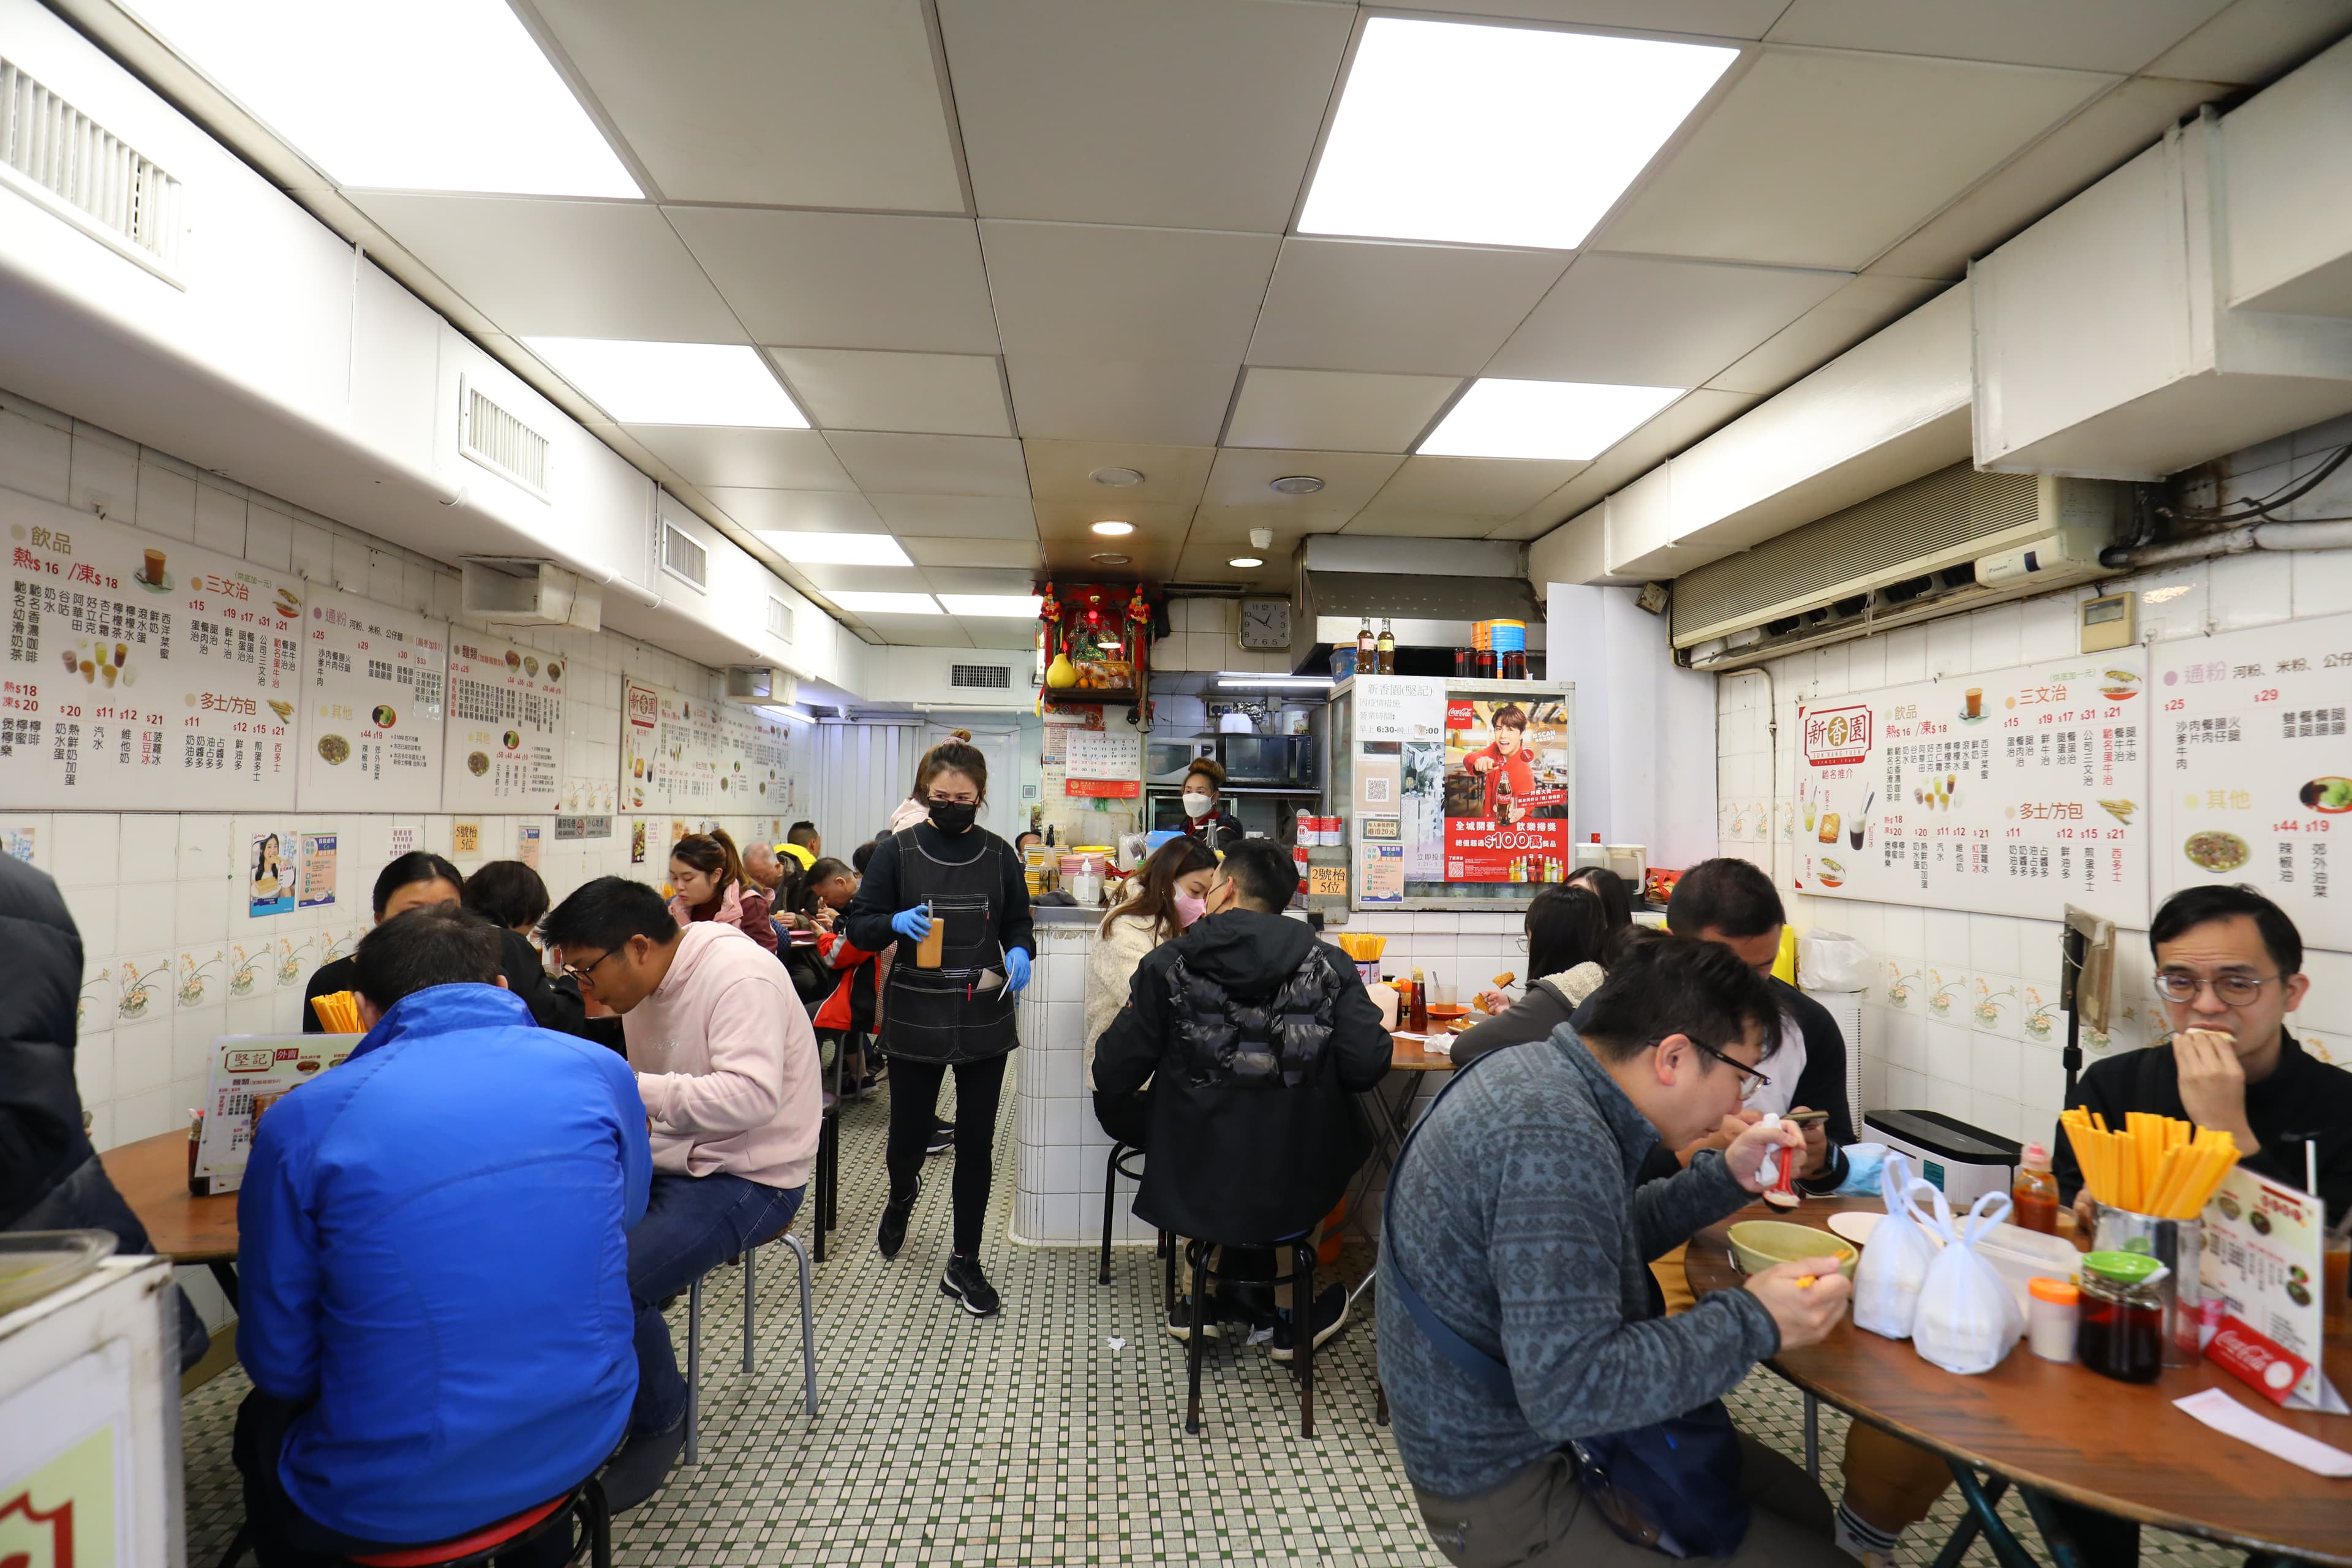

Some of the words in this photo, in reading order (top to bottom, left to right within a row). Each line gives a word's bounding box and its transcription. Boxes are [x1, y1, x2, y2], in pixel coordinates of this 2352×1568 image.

[31, 526, 72, 556] 飲品
[206, 575, 249, 601] 三文治
[43, 587, 56, 612] 奶水
[58, 590, 70, 616] 谷咕
[189, 600, 204, 611] $15
[10, 580, 26, 662] 馳名幼滑奶茶
[72, 593, 84, 631] 阿華田
[85, 596, 97, 634] 好立克
[99, 600, 110, 637] 杏仁霜
[111, 602, 123, 639] 檸檬茶
[224, 608, 236, 618] $19
[241, 612, 254, 622] $17
[325, 608, 347, 627] 通粉
[26, 584, 42, 663] 馳名香濃咖啡
[124, 605, 135, 641] 檸檬水
[137, 608, 148, 643] 滾水蛋
[149, 611, 159, 634] 鮮奶
[190, 620, 200, 642] 蛋治
[258, 617, 270, 627] $31
[276, 621, 287, 631] $21
[160, 613, 171, 660] 西洋菜蜜
[200, 622, 209, 655] 餐肉治
[209, 624, 218, 646] 腿治
[224, 627, 233, 659] 鮮牛治
[313, 631, 324, 639] $25
[258, 635, 267, 686] 公司三文治
[325, 650, 332, 668] 肉片
[462, 645, 477, 660] 麵類
[2185, 661, 2226, 685] 通粉
[1368, 684, 1433, 696] 新香園(堅記)
[2020, 684, 2067, 704] 三文治
[2254, 689, 2278, 702] $29
[97, 707, 113, 718] $11
[201, 692, 256, 715] 多士/方包
[332, 704, 353, 720] 其他
[1449, 707, 1472, 717] Coca-Cola
[1894, 704, 1917, 720] 飲品
[2105, 707, 2120, 717] $21
[2165, 699, 2185, 710] $25
[120, 709, 137, 720] $12
[147, 715, 163, 725] $21
[185, 717, 199, 726] $11
[2004, 717, 2019, 727] $15
[2039, 714, 2052, 724] $19
[2059, 712, 2073, 722] $17
[2081, 710, 2095, 720] $31
[15, 718, 28, 745] 檸蜜
[28, 720, 42, 745] 檸啡
[233, 722, 247, 731] $12
[253, 725, 266, 734] $15
[273, 726, 284, 736] $21
[1808, 714, 1866, 748] 新香園
[1, 718, 15, 756] 煲檸樂
[54, 723, 66, 760] 奶水蛋
[93, 726, 104, 750] 汽水
[119, 728, 132, 764] 維他奶
[2176, 721, 2187, 769] 沙爹牛肉
[65, 724, 80, 786] 熱鮮奶加蛋
[141, 731, 153, 764] 紅豆冰
[152, 732, 163, 766] 菠蘿冰
[185, 735, 194, 767] 奶油多
[206, 737, 215, 769] 油占多
[235, 739, 243, 770] 鮮油多
[253, 741, 263, 781] 煎蛋多士
[2083, 730, 2093, 786] 公司三文治
[2207, 790, 2251, 809] 其他
[2020, 802, 2083, 820] 多士/方包
[456, 827, 477, 837] 5號枱
[1456, 821, 1495, 831] 全城開蓋
[1517, 823, 1556, 831] 飲樂掃獎
[1953, 827, 1965, 836] $12
[2007, 828, 2020, 837] $11
[2057, 829, 2073, 839] $12
[2081, 829, 2097, 839] $15
[2107, 829, 2124, 839] $21
[2274, 821, 2299, 832] $44
[2305, 820, 2330, 832] $19
[461, 839, 473, 850] 5位
[1937, 843, 1944, 861] 汽水
[2084, 848, 2095, 892] 煎蛋多士
[2112, 848, 2122, 882] 西多士
[1312, 869, 1345, 881] 2號枱
[1321, 881, 1340, 894] 5位
[235, 1054, 267, 1066] 堅記
[277, 1050, 297, 1059] 外賣
